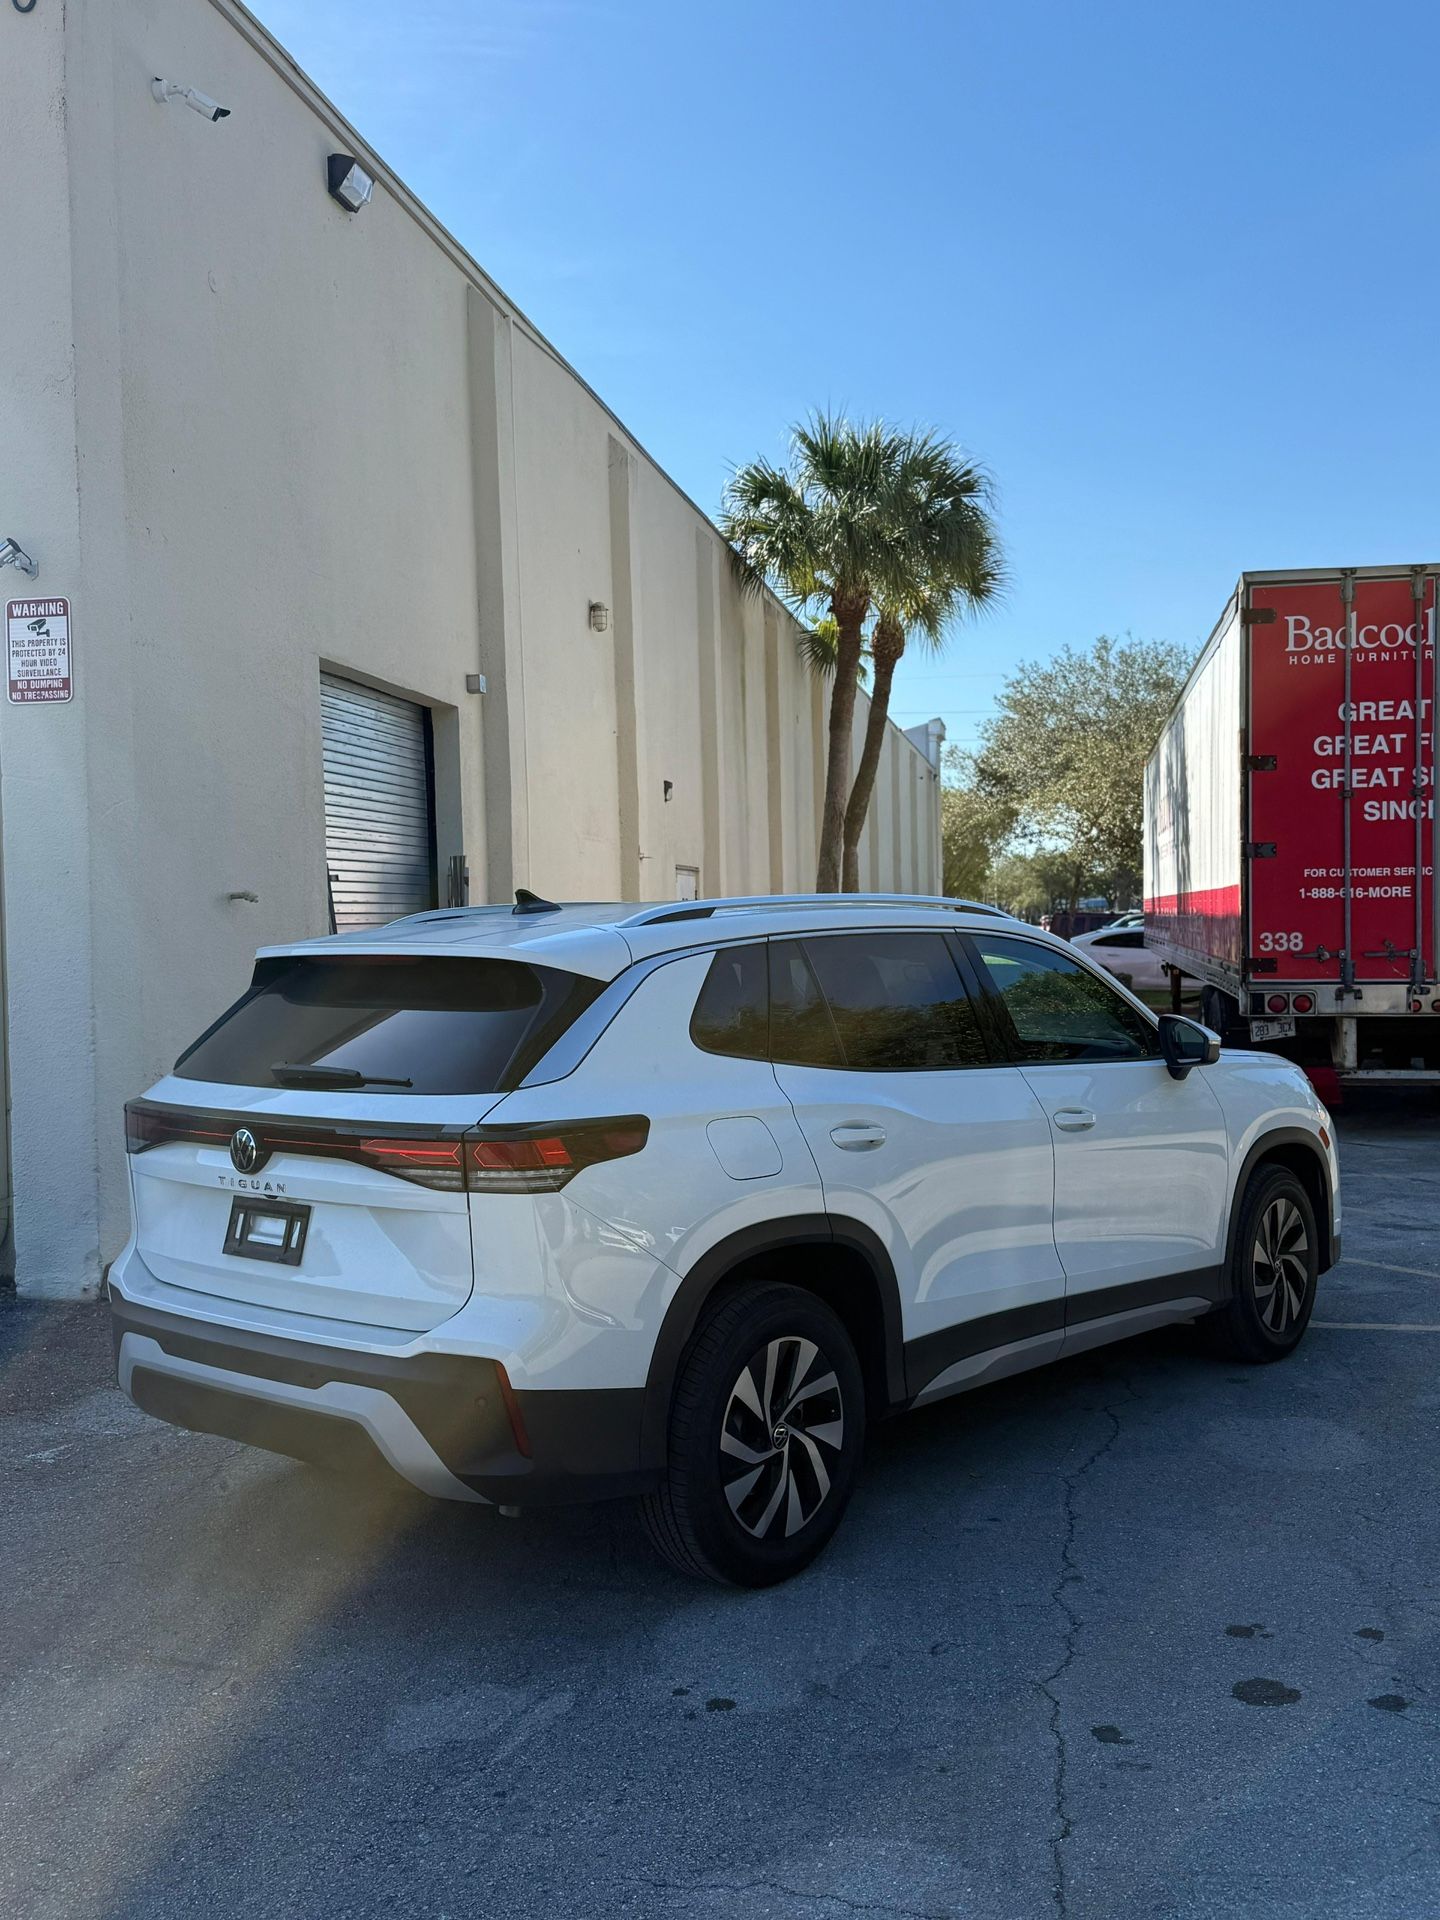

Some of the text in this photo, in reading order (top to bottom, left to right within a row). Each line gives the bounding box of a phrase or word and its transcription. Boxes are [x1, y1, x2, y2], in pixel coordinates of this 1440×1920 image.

[12, 601, 64, 617] WARNING
[12, 637, 67, 648] THIS PROPERTY IS
[12, 648, 66, 658] PROTECTED BY 24
[1289, 649, 1433, 665] HOME URNITR
[21, 658, 58, 668] HOUR VIDEO
[17, 668, 62, 678] SURVEILLANCE
[17, 679, 63, 690] NO DUMPING
[12, 690, 69, 700] NO TRESPASSING
[1337, 699, 1432, 722] GREAT
[1313, 733, 1408, 757] GREAT
[1304, 866, 1433, 878] FOR CUTOMER SERIC
[1259, 932, 1304, 952] 338
[218, 1175, 287, 1194] TIGUAN
